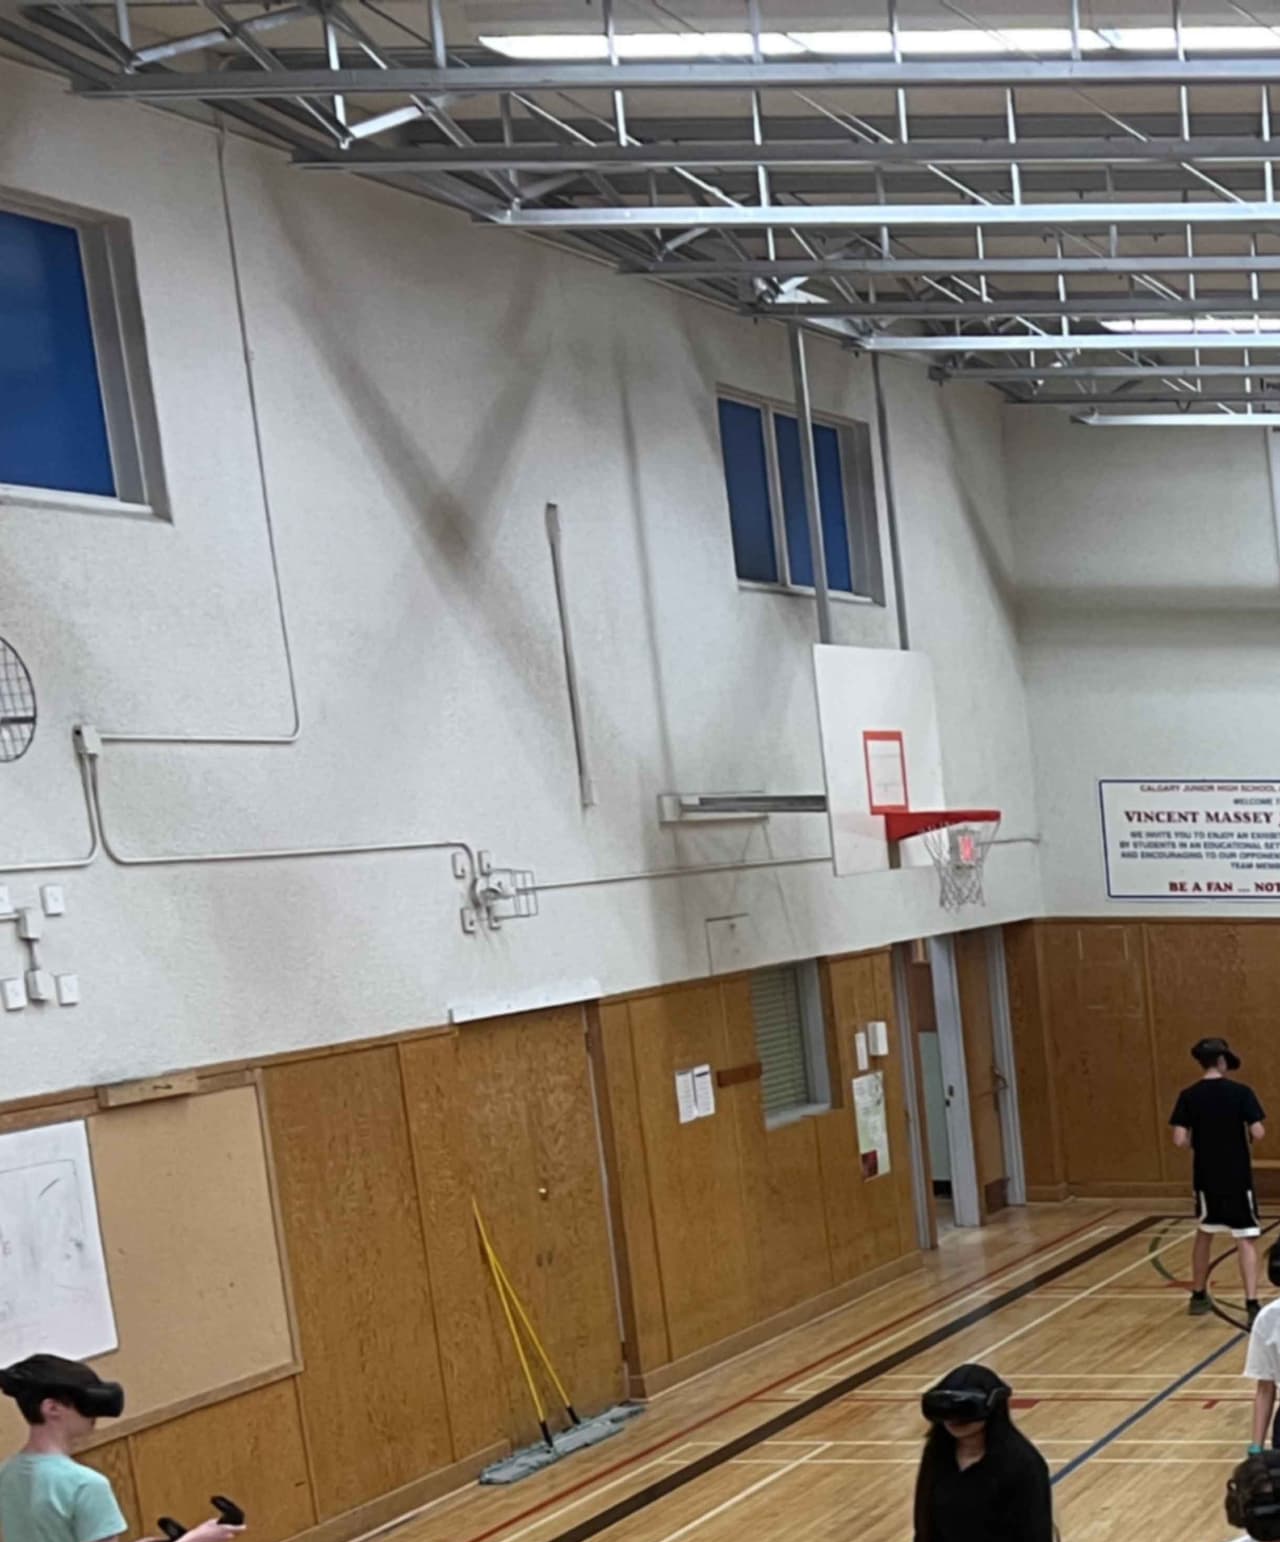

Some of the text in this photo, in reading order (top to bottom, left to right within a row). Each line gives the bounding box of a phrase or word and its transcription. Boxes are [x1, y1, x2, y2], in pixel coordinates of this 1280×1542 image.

[1241, 785, 1276, 793] SCHOOL
[1124, 811, 1199, 823] VINCENT
[1205, 811, 1273, 824] MASSEY
[1169, 882, 1188, 892] BE
[1192, 882, 1202, 892] A
[1206, 882, 1233, 892] FAN
